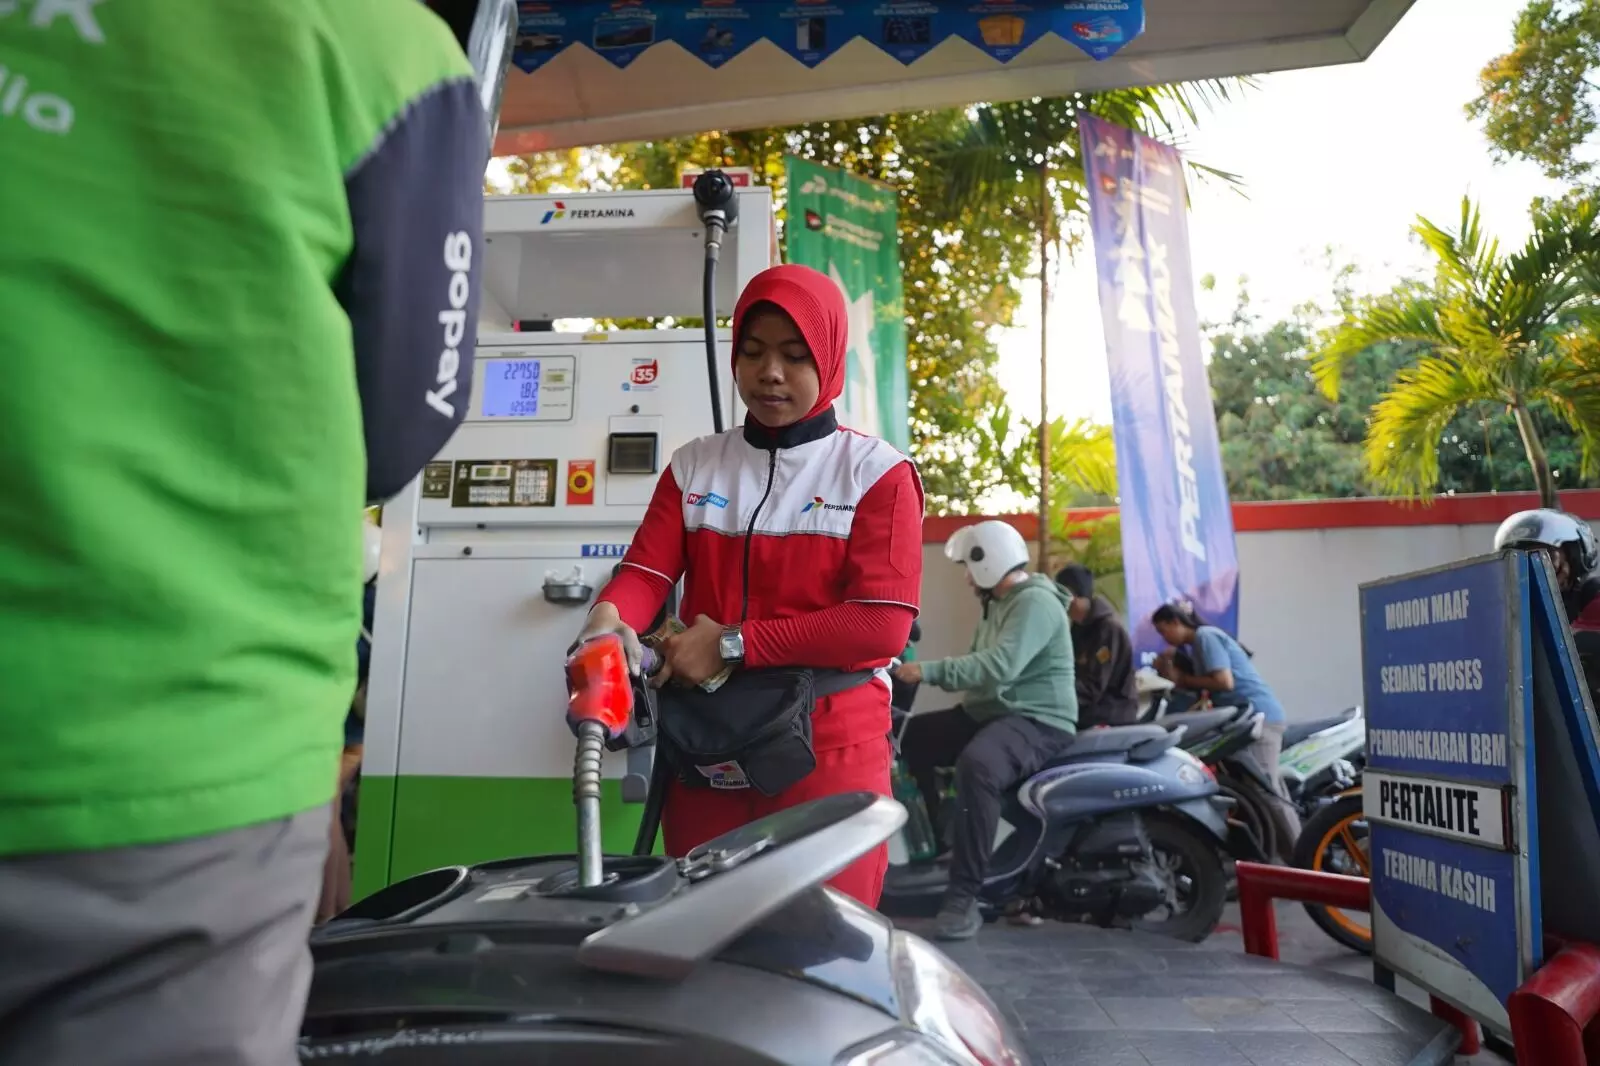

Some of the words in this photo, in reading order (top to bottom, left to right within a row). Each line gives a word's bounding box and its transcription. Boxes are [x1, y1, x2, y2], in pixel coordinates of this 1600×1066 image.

[570, 208, 635, 219] PERTAMINA
[426, 230, 473, 418] gopay
[1385, 597, 1429, 631] MOHON
[1431, 589, 1469, 623] MAAF
[1380, 663, 1427, 694] SEDANG
[1428, 659, 1483, 693] PROSES
[1369, 729, 1468, 763] PEMBONGKARAN
[1470, 733, 1507, 767] BBM
[1379, 780, 1480, 836] PERTALITE
[1382, 848, 1438, 893] TERIMA
[1440, 863, 1497, 914] KASIH
